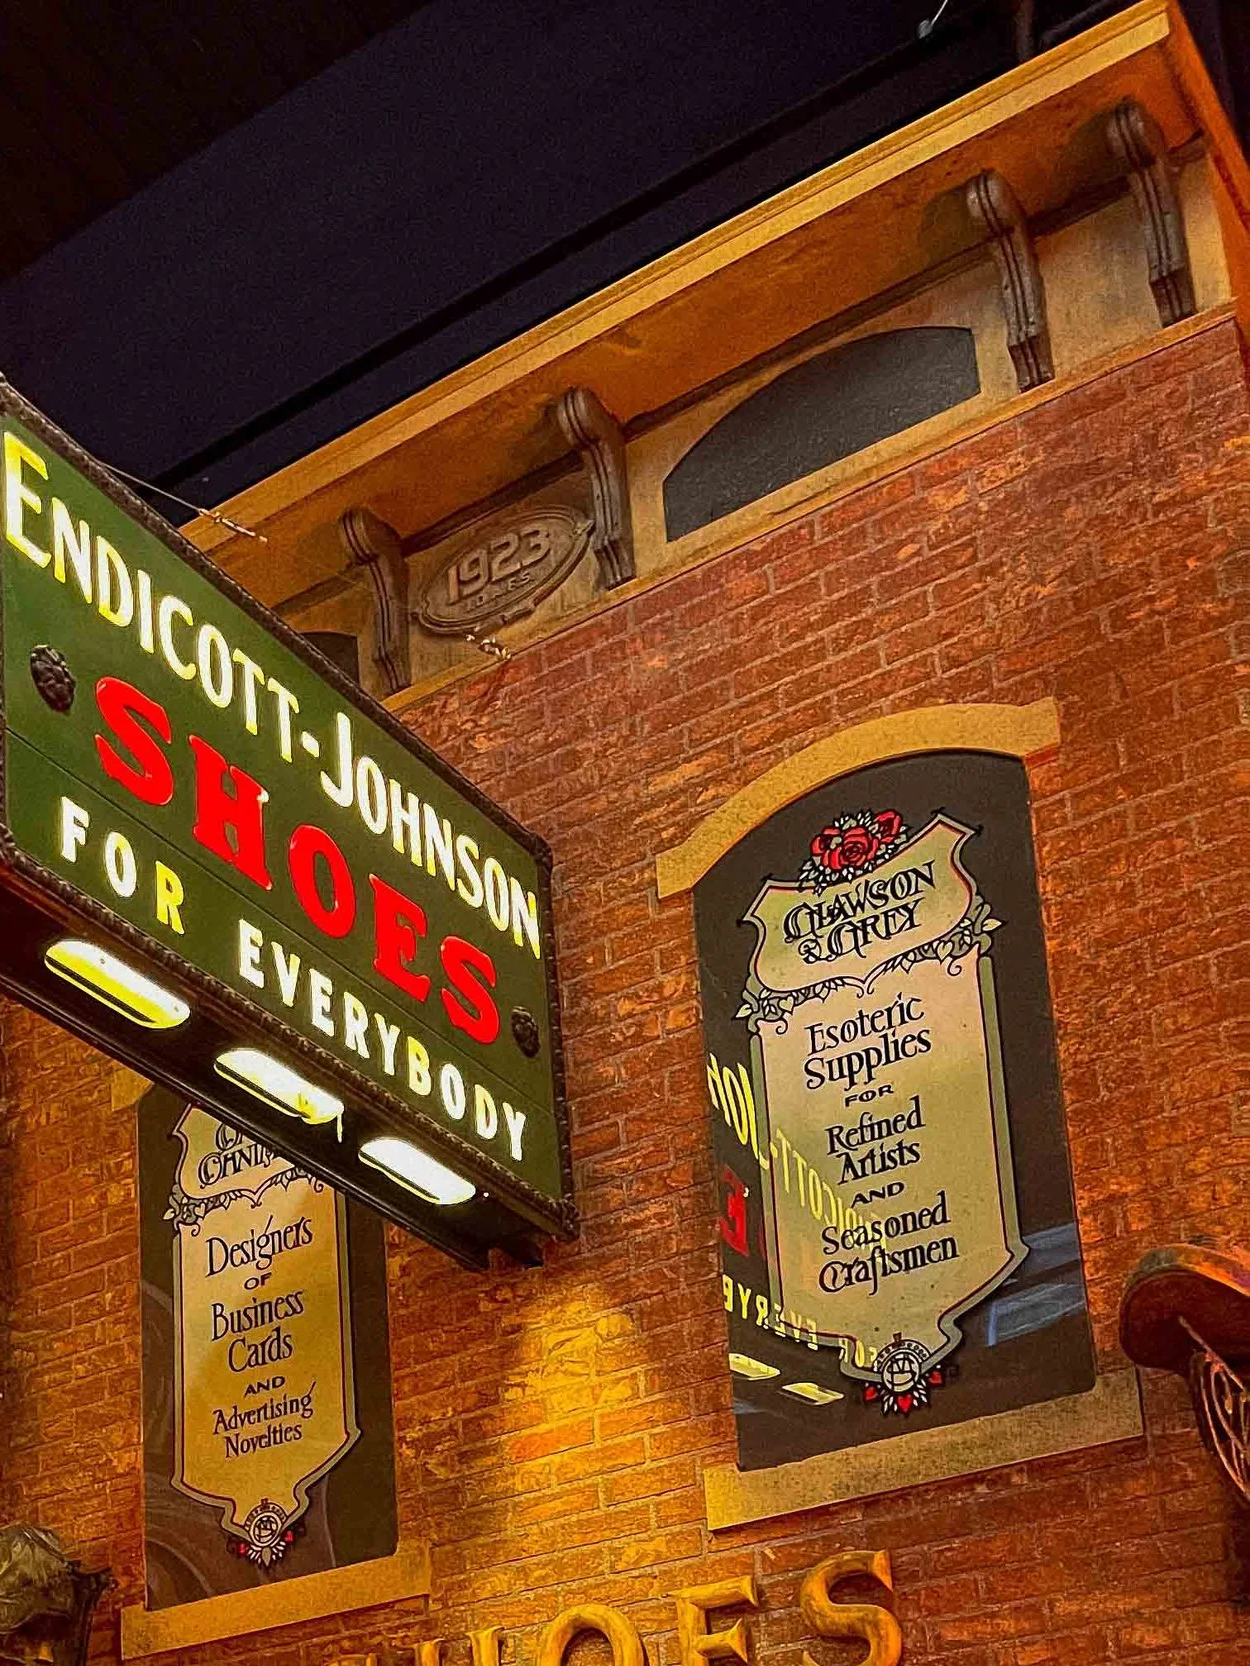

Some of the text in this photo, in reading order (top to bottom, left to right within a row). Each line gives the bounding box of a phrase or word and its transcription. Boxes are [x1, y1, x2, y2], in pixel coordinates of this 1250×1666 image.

[447, 529, 551, 606] 1923
[95, 676, 500, 1044] SHOES
[60, 797, 527, 1161] FOR EVERYBODY
[805, 993, 926, 1056] Esoteric
[803, 1027, 931, 1090] Supplies
[845, 1085, 894, 1107] FOR
[826, 1096, 925, 1156] Refined
[837, 1140, 920, 1186] Artists
[851, 1182, 905, 1208] AND
[205, 1215, 313, 1277] Designers
[822, 1192, 950, 1256] Seasoned
[244, 1273, 272, 1291] OF
[819, 1237, 959, 1295] Craftsmen
[211, 1290, 304, 1341] Business
[228, 1327, 293, 1373] Cards
[212, 1381, 316, 1434] Advertising
[244, 1376, 286, 1397] AND
[225, 1422, 303, 1458] Novelties
